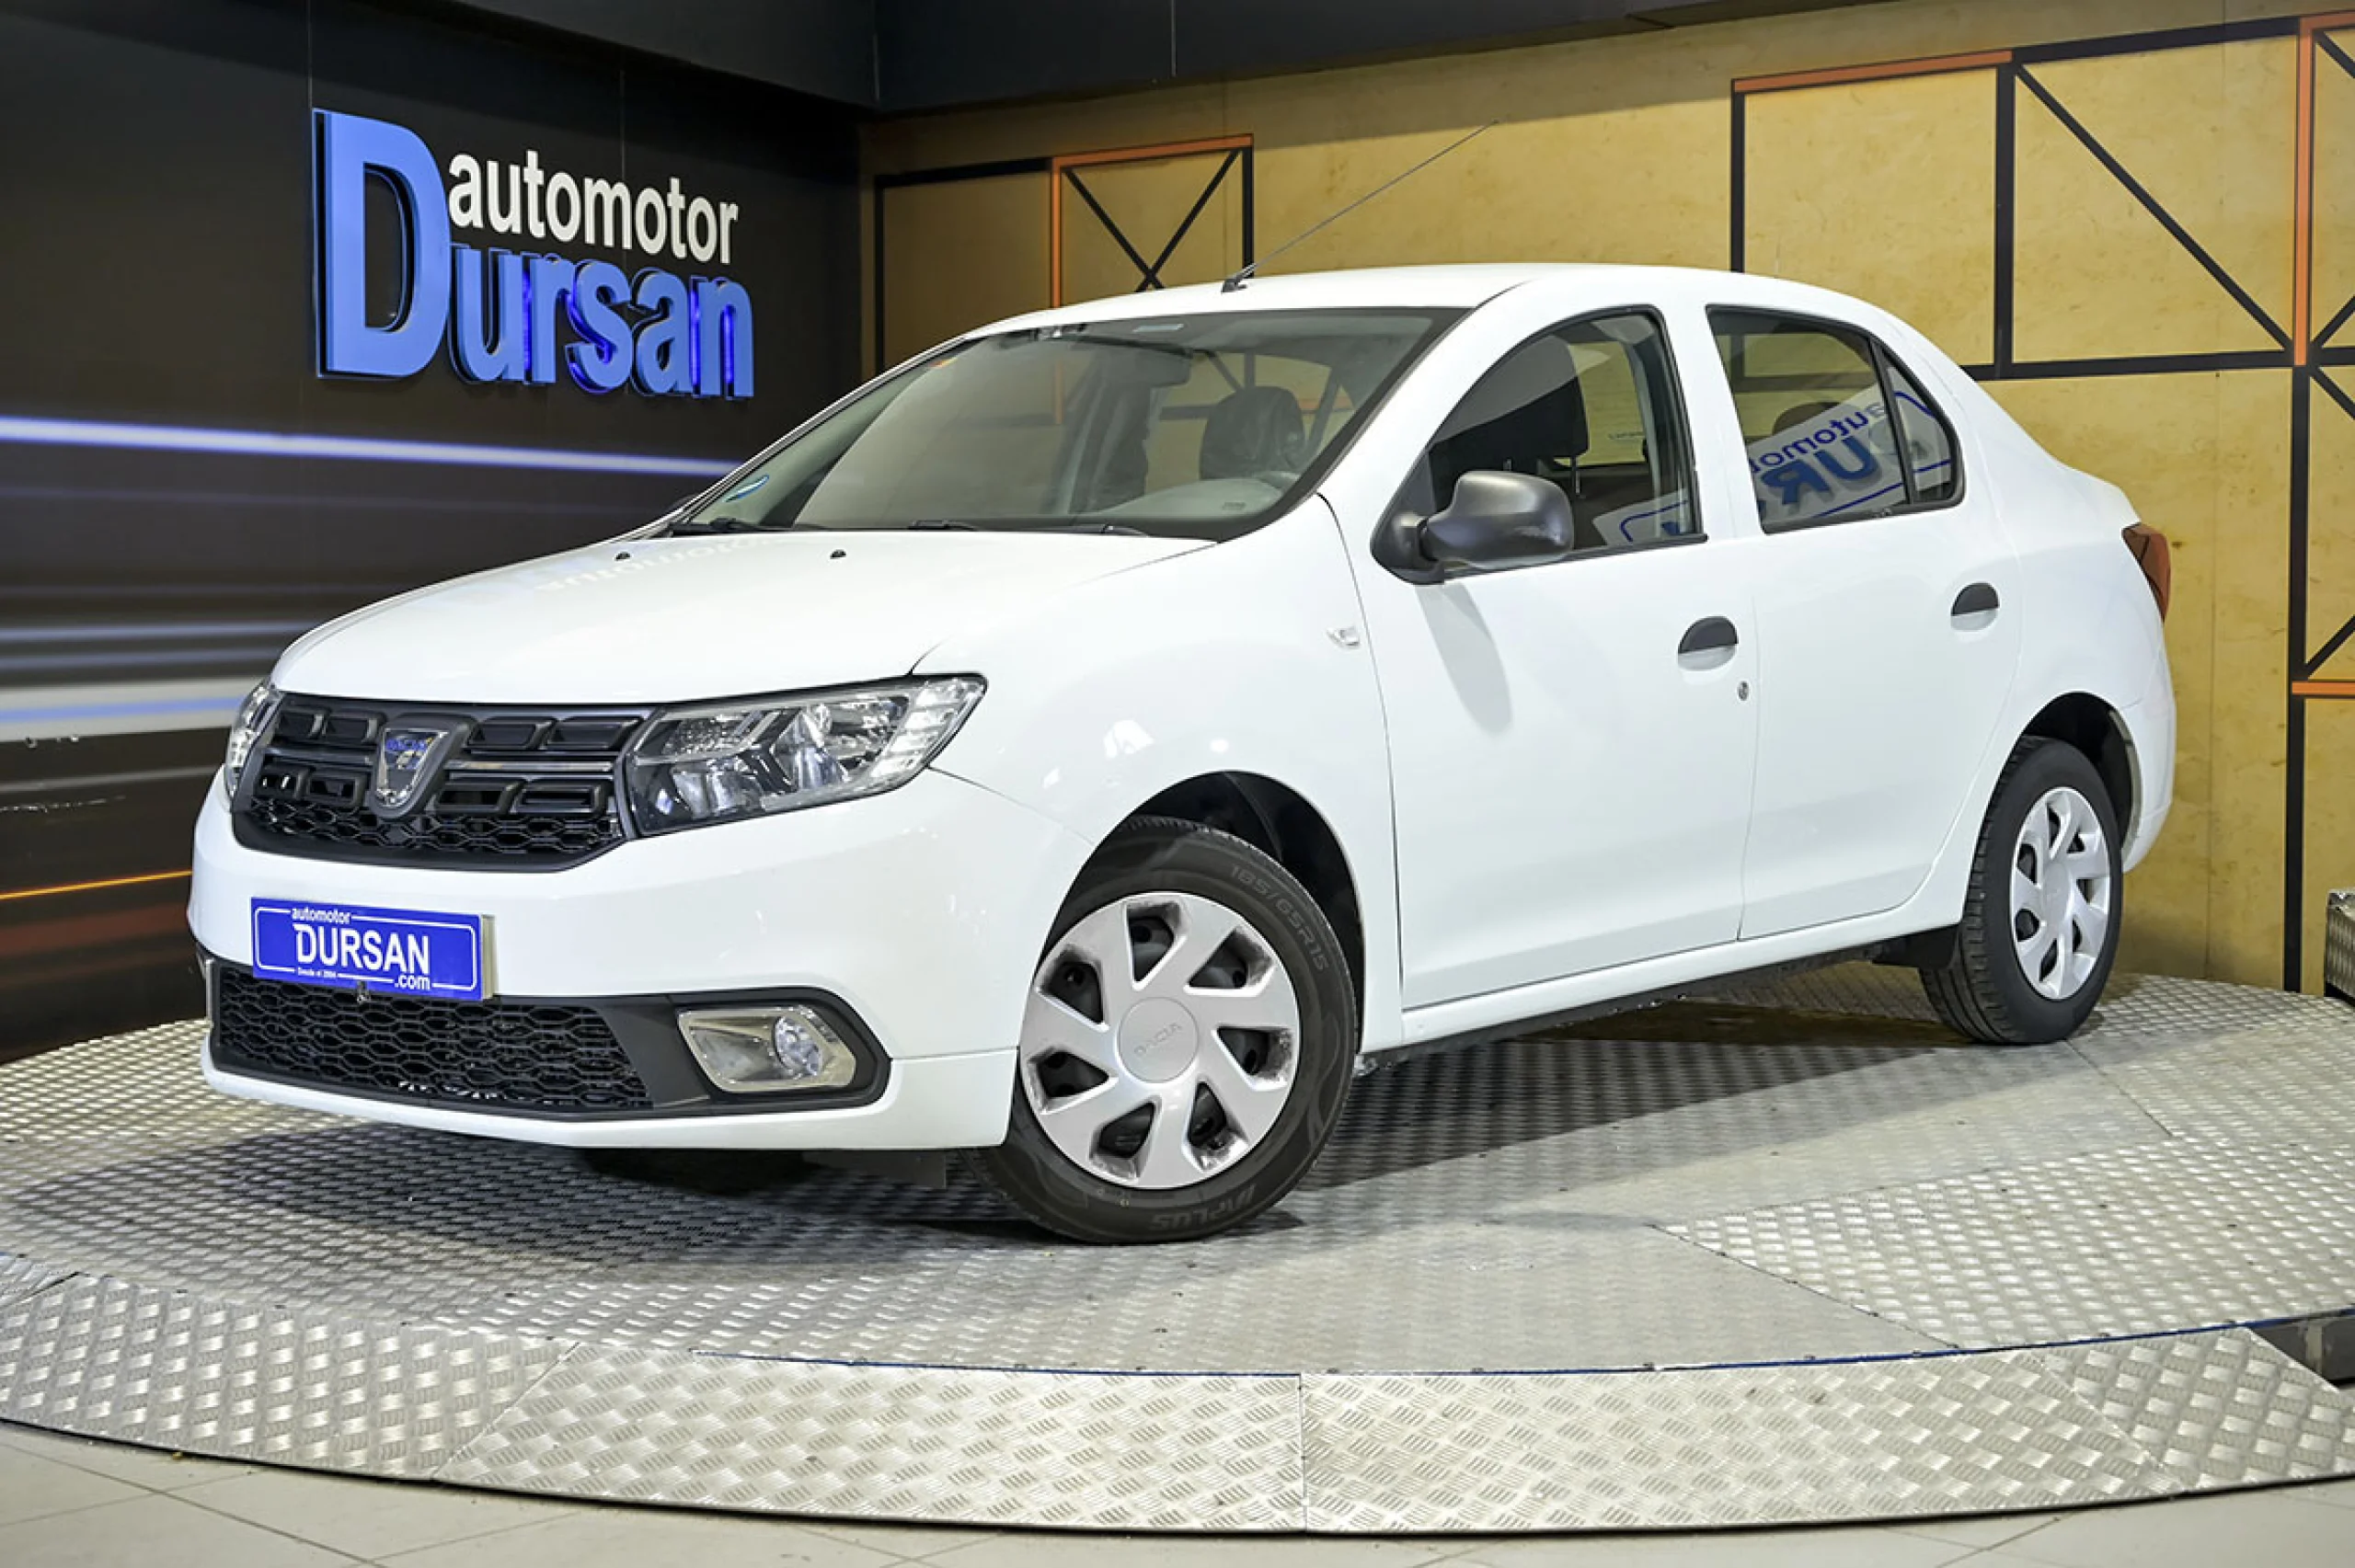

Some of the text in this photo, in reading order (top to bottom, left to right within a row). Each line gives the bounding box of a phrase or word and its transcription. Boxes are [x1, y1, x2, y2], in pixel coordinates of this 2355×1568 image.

[447, 150, 739, 264] automotor
[311, 107, 754, 399] Dursan
[291, 907, 351, 925] automotor
[292, 922, 431, 975] DURSAN
[394, 974, 431, 990] .com
[1133, 1023, 1183, 1058] DACIA
